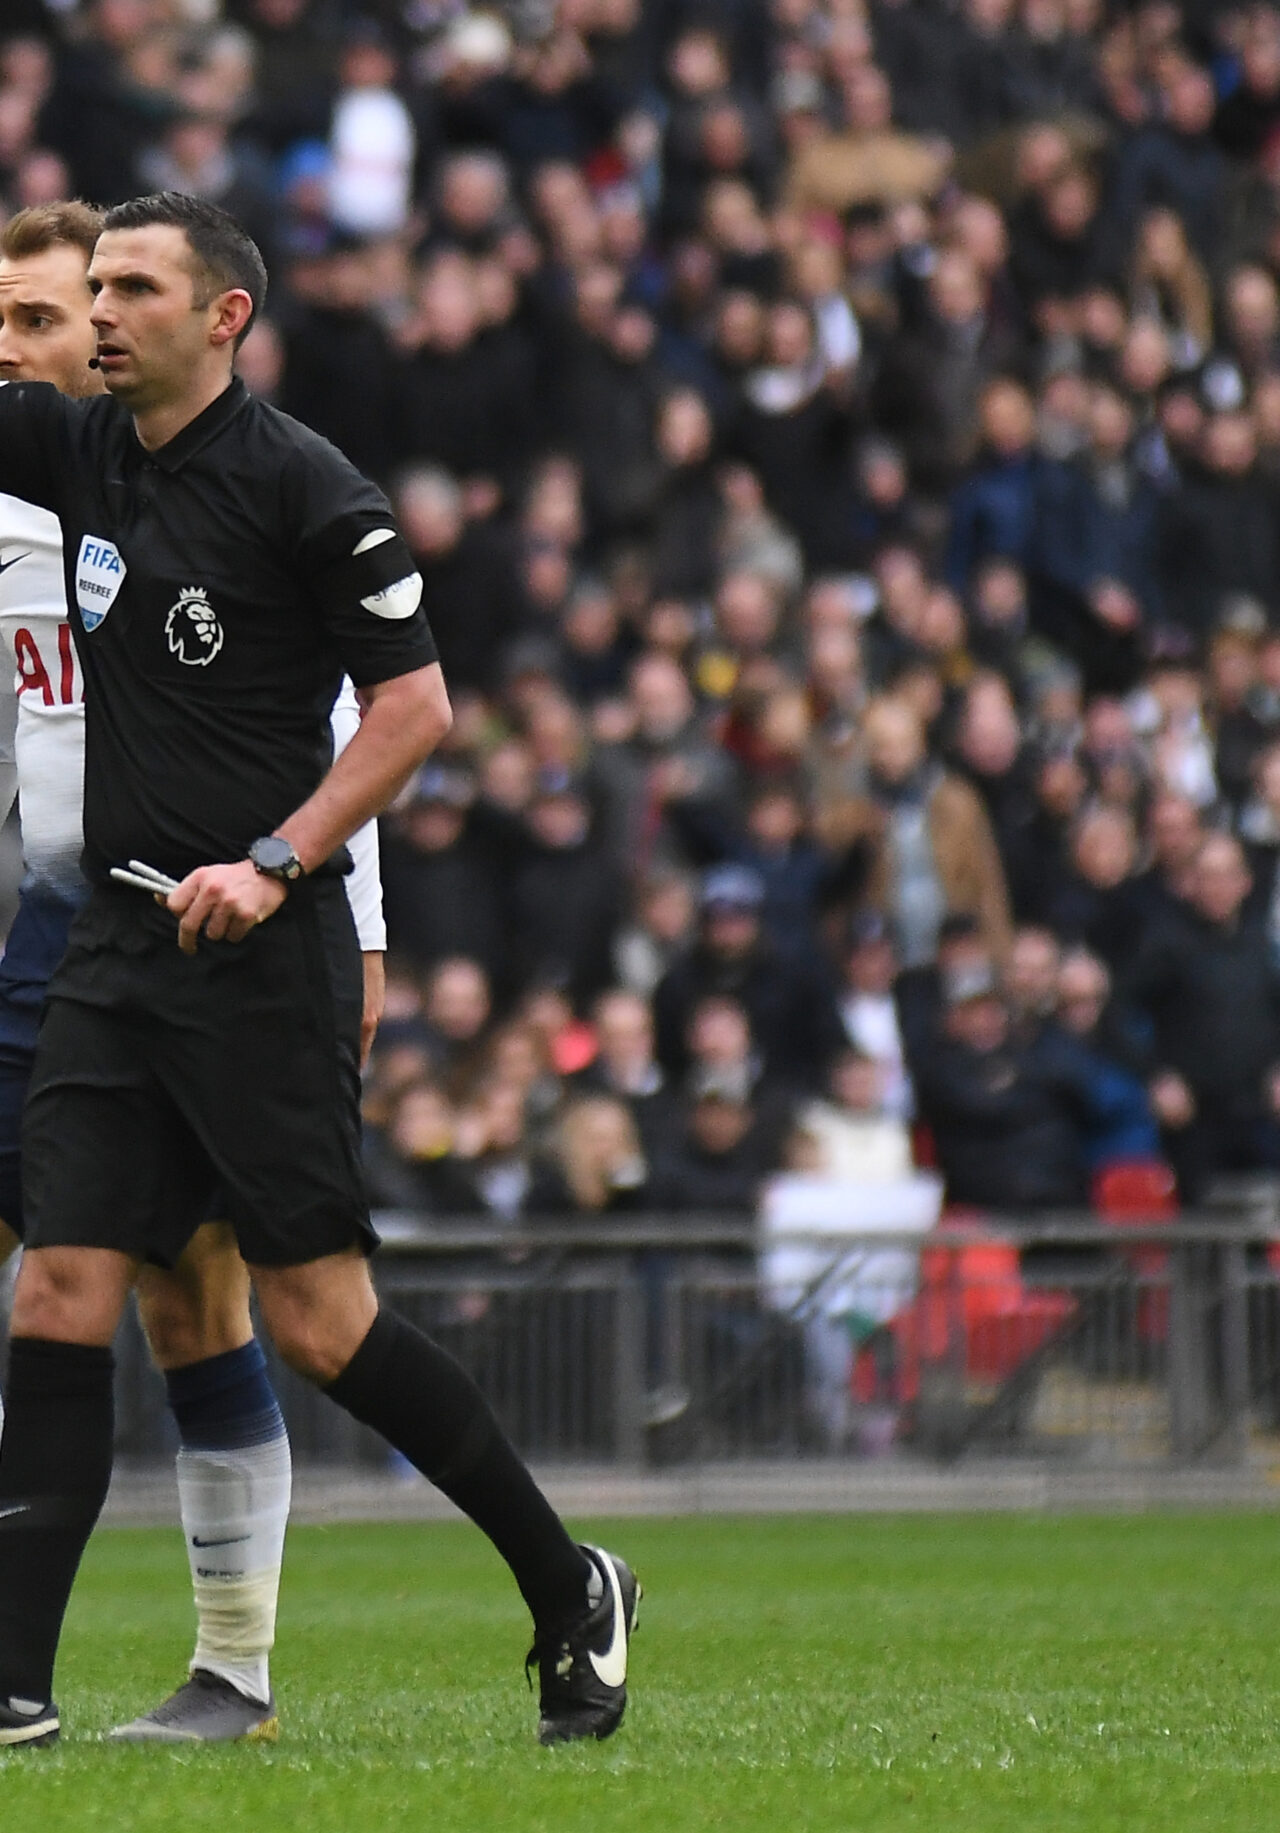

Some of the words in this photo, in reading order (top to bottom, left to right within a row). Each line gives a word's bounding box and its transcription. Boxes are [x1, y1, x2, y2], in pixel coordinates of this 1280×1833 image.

[82, 543, 120, 574] FIFA
[79, 578, 113, 599] REFEREE
[14, 623, 86, 706] AI
